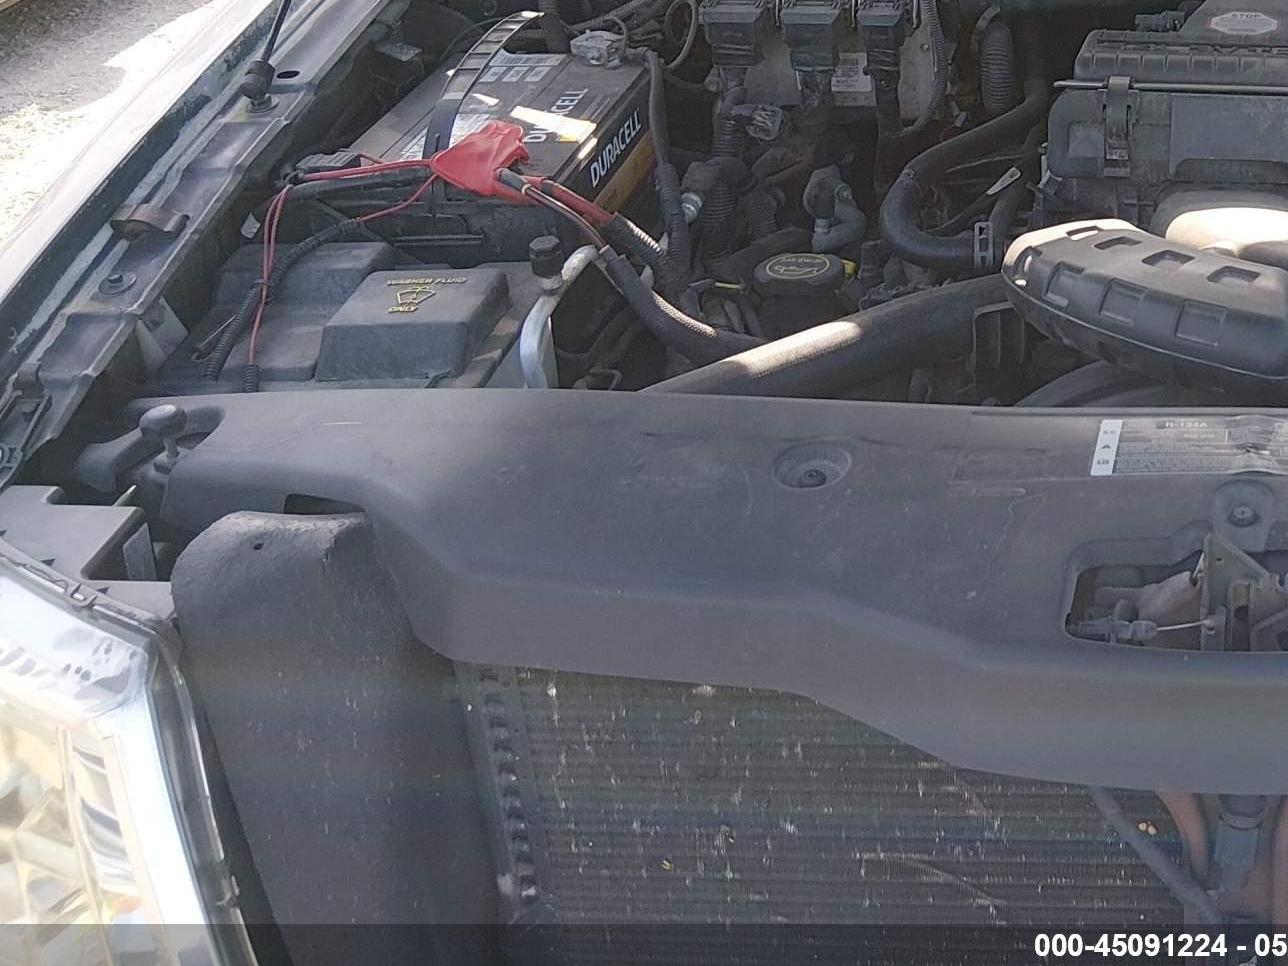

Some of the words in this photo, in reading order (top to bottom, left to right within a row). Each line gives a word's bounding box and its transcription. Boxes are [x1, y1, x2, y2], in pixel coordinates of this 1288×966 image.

[522, 88, 589, 143] DUCELL
[590, 110, 642, 188] DURACELL
[387, 277, 433, 286] WASHER
[434, 276, 467, 284] FLUID
[388, 305, 418, 313] ONLY
